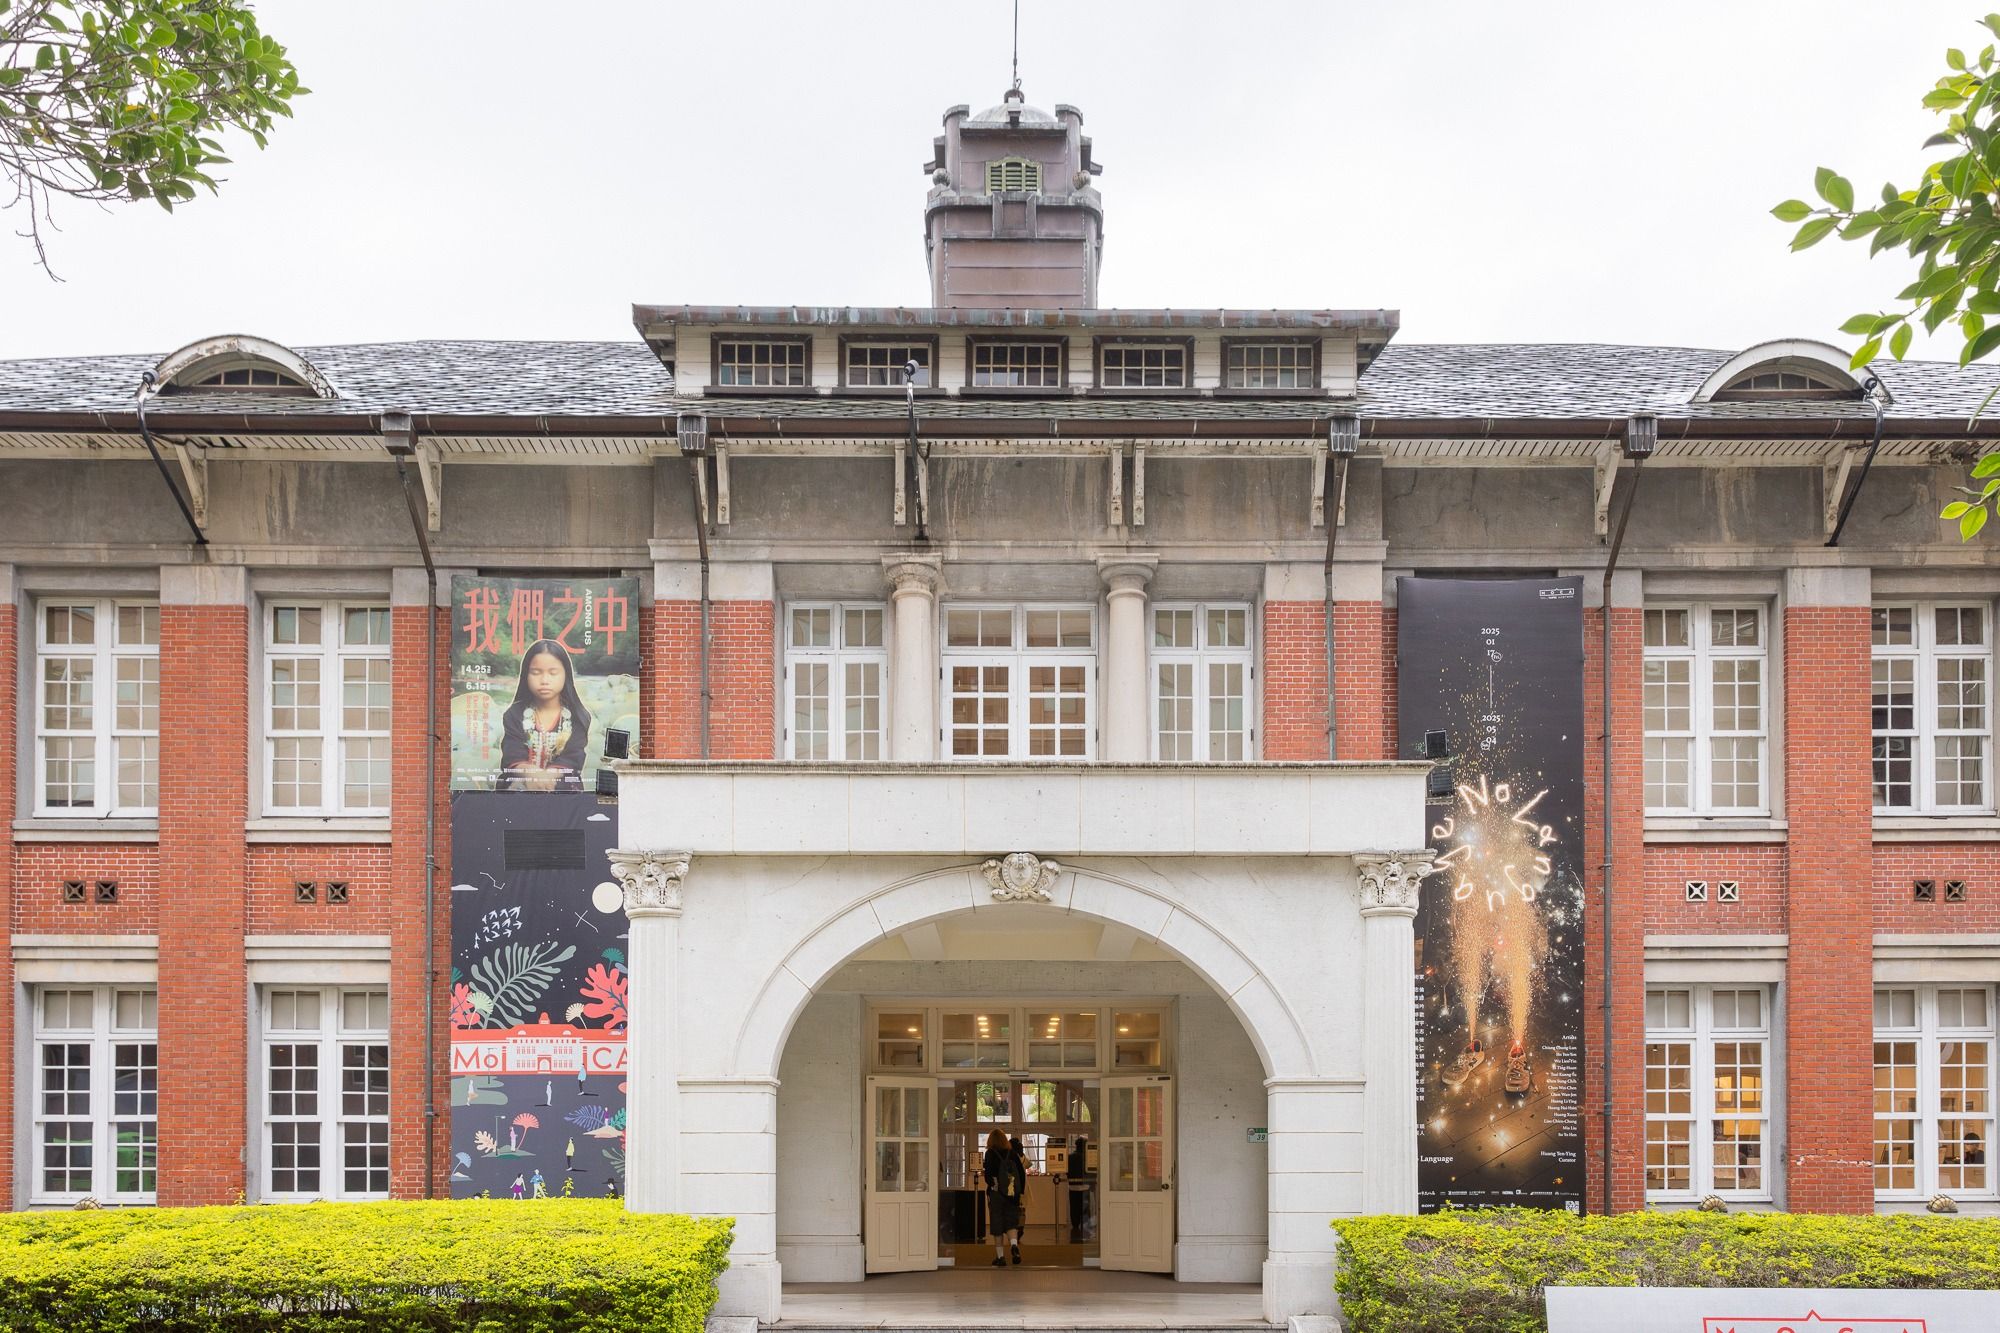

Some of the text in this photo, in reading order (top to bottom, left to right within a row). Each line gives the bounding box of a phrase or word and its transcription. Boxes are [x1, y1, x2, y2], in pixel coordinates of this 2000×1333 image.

[463, 587, 628, 656] 我們之中
[584, 588, 592, 646] AMONG US
[1481, 628, 1500, 636] 2025
[465, 664, 487, 674] 4.25
[465, 682, 487, 691] 6.15
[1482, 715, 1500, 723] 2025
[1486, 726, 1496, 734] 05
[1420, 1155, 1454, 1164] Language
